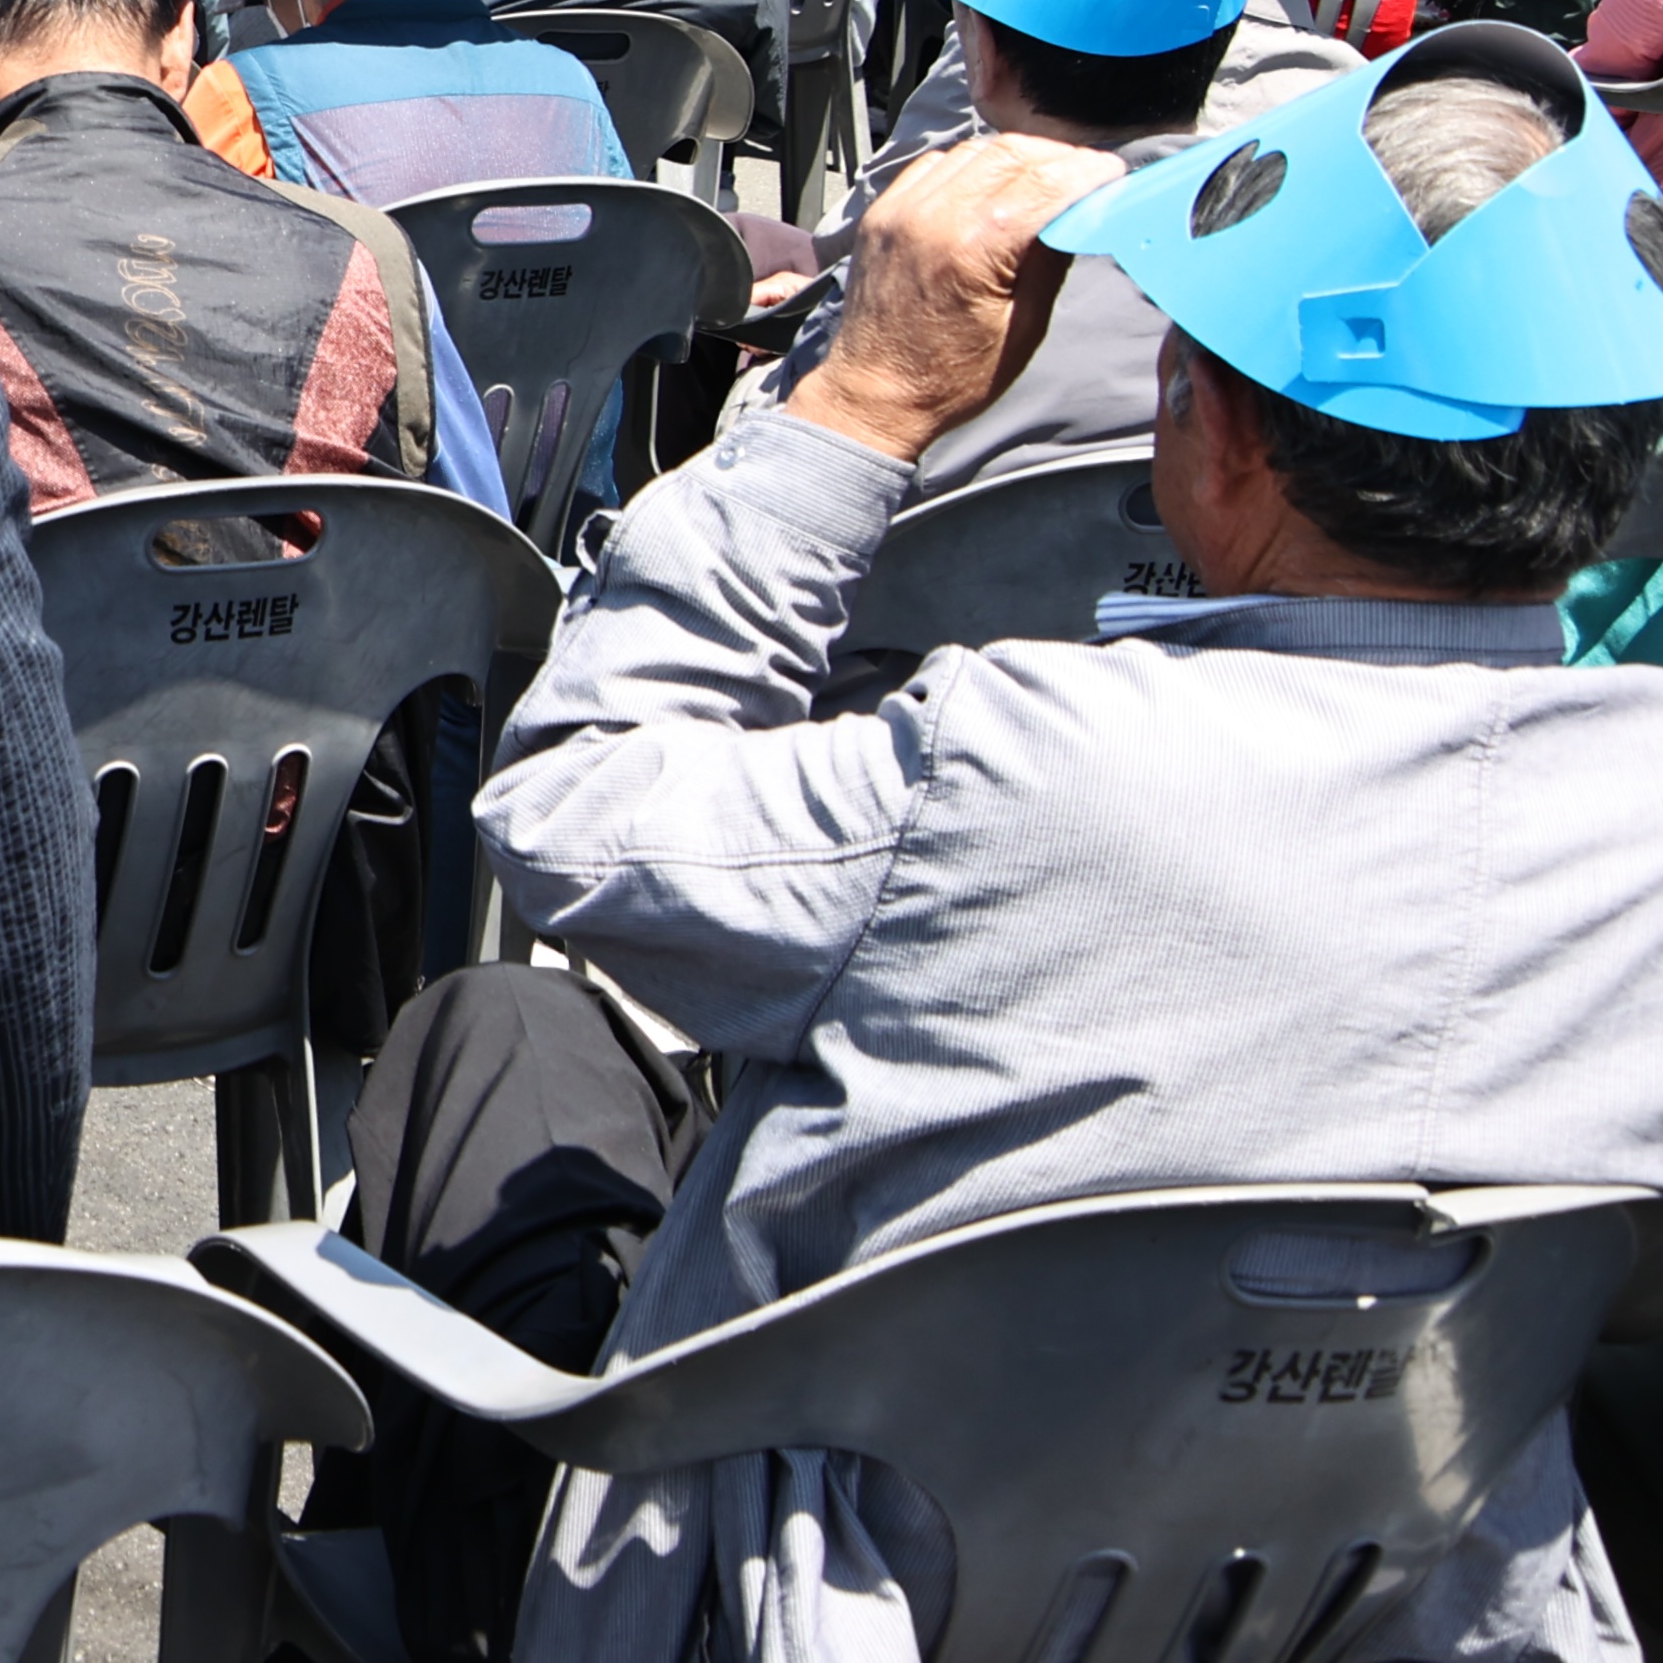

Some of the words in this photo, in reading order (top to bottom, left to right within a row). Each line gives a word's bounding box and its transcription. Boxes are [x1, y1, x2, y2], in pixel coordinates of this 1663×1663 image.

[479, 265, 573, 301] 강산렌탈
[170, 593, 299, 645] 강산렌탈
[1219, 1346, 1416, 1404] 강산렌탈
